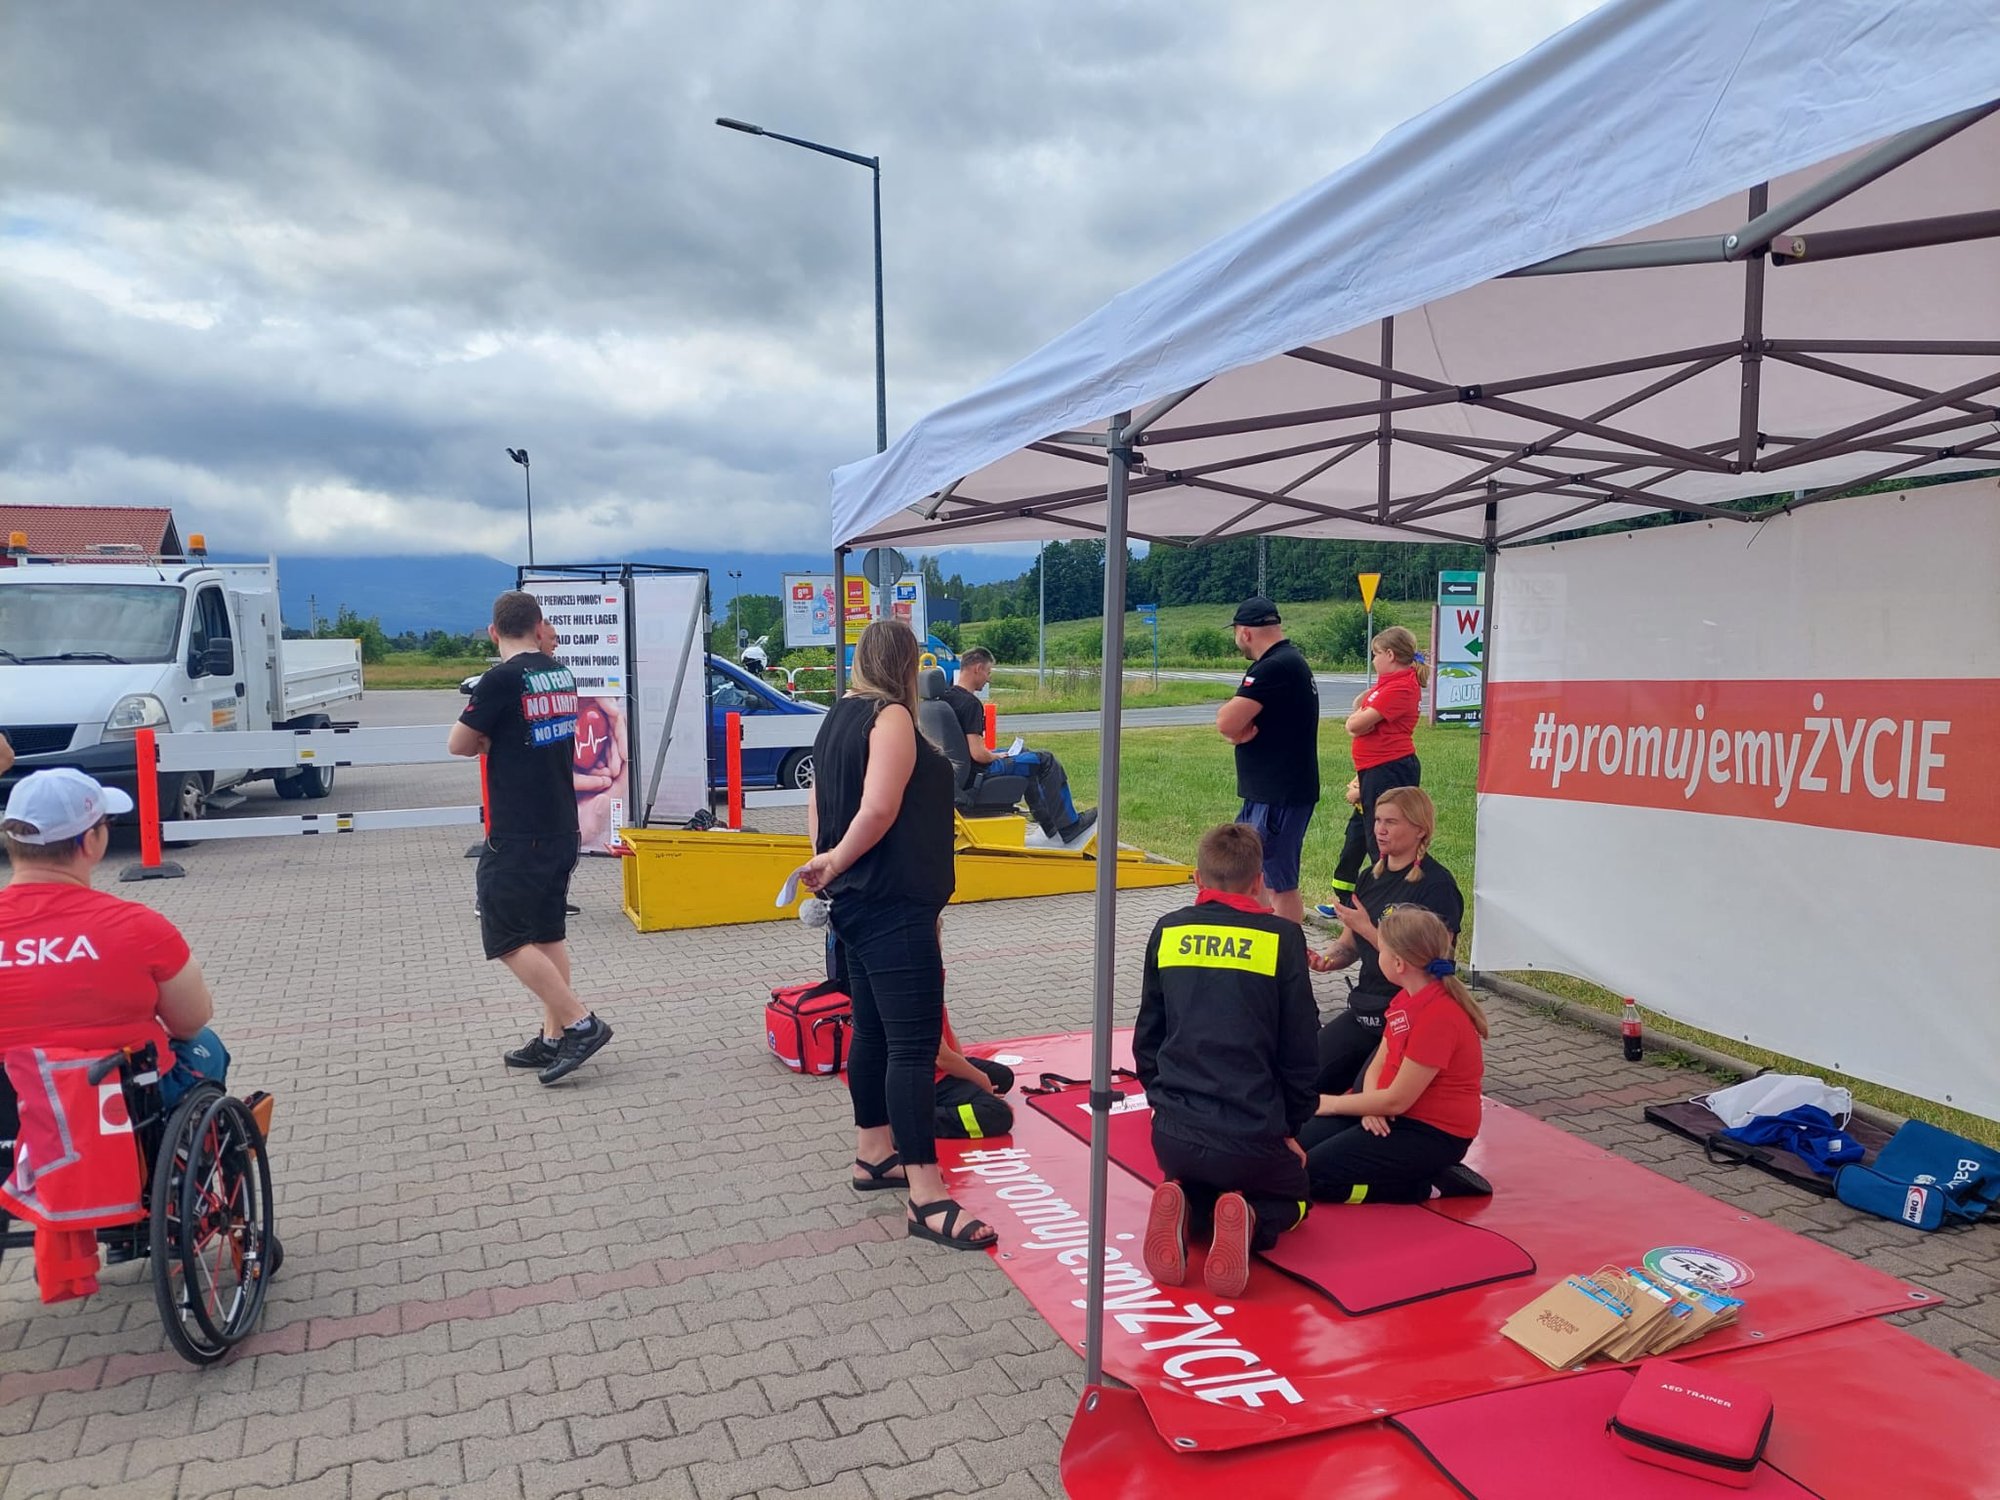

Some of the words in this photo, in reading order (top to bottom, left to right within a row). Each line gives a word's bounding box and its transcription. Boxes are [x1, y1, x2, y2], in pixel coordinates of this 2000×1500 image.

[544, 595, 575, 606] PIERWSZEJ
[577, 594, 601, 605] POMOCY
[549, 614, 571, 625] ERSTE
[573, 614, 593, 625] HILFE
[594, 613, 617, 625] LAGER
[556, 634, 571, 645] AID
[573, 634, 599, 645] CAMP
[593, 655, 619, 666] POMOCI
[529, 673, 551, 693] NO
[526, 696, 549, 716] NO
[534, 726, 552, 742] NO
[1530, 692, 1952, 808] #promujemyŻYCIE
[1908, 1200, 1919, 1221] DBW
[1661, 1384, 1683, 1393] AED
[1686, 1389, 1732, 1408] TRAINER
